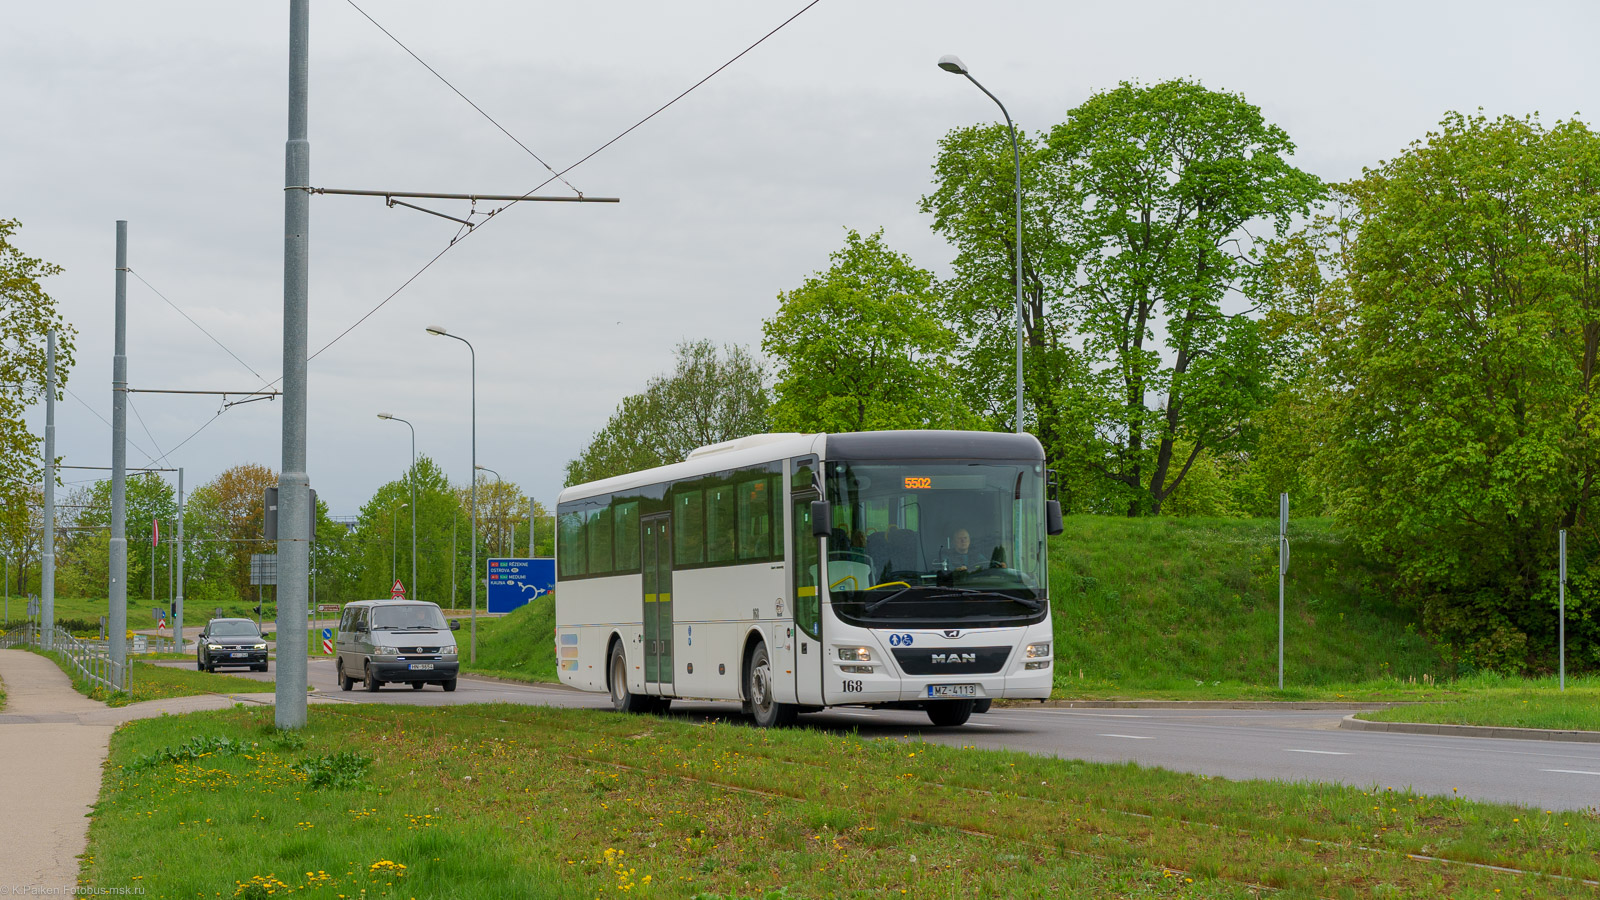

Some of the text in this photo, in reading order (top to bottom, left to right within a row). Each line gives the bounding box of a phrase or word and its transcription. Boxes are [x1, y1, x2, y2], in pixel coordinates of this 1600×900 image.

[904, 477, 931, 489] 5502
[931, 653, 976, 664] MAN
[842, 680, 863, 693] 168
[935, 685, 975, 695] MZ-4113
